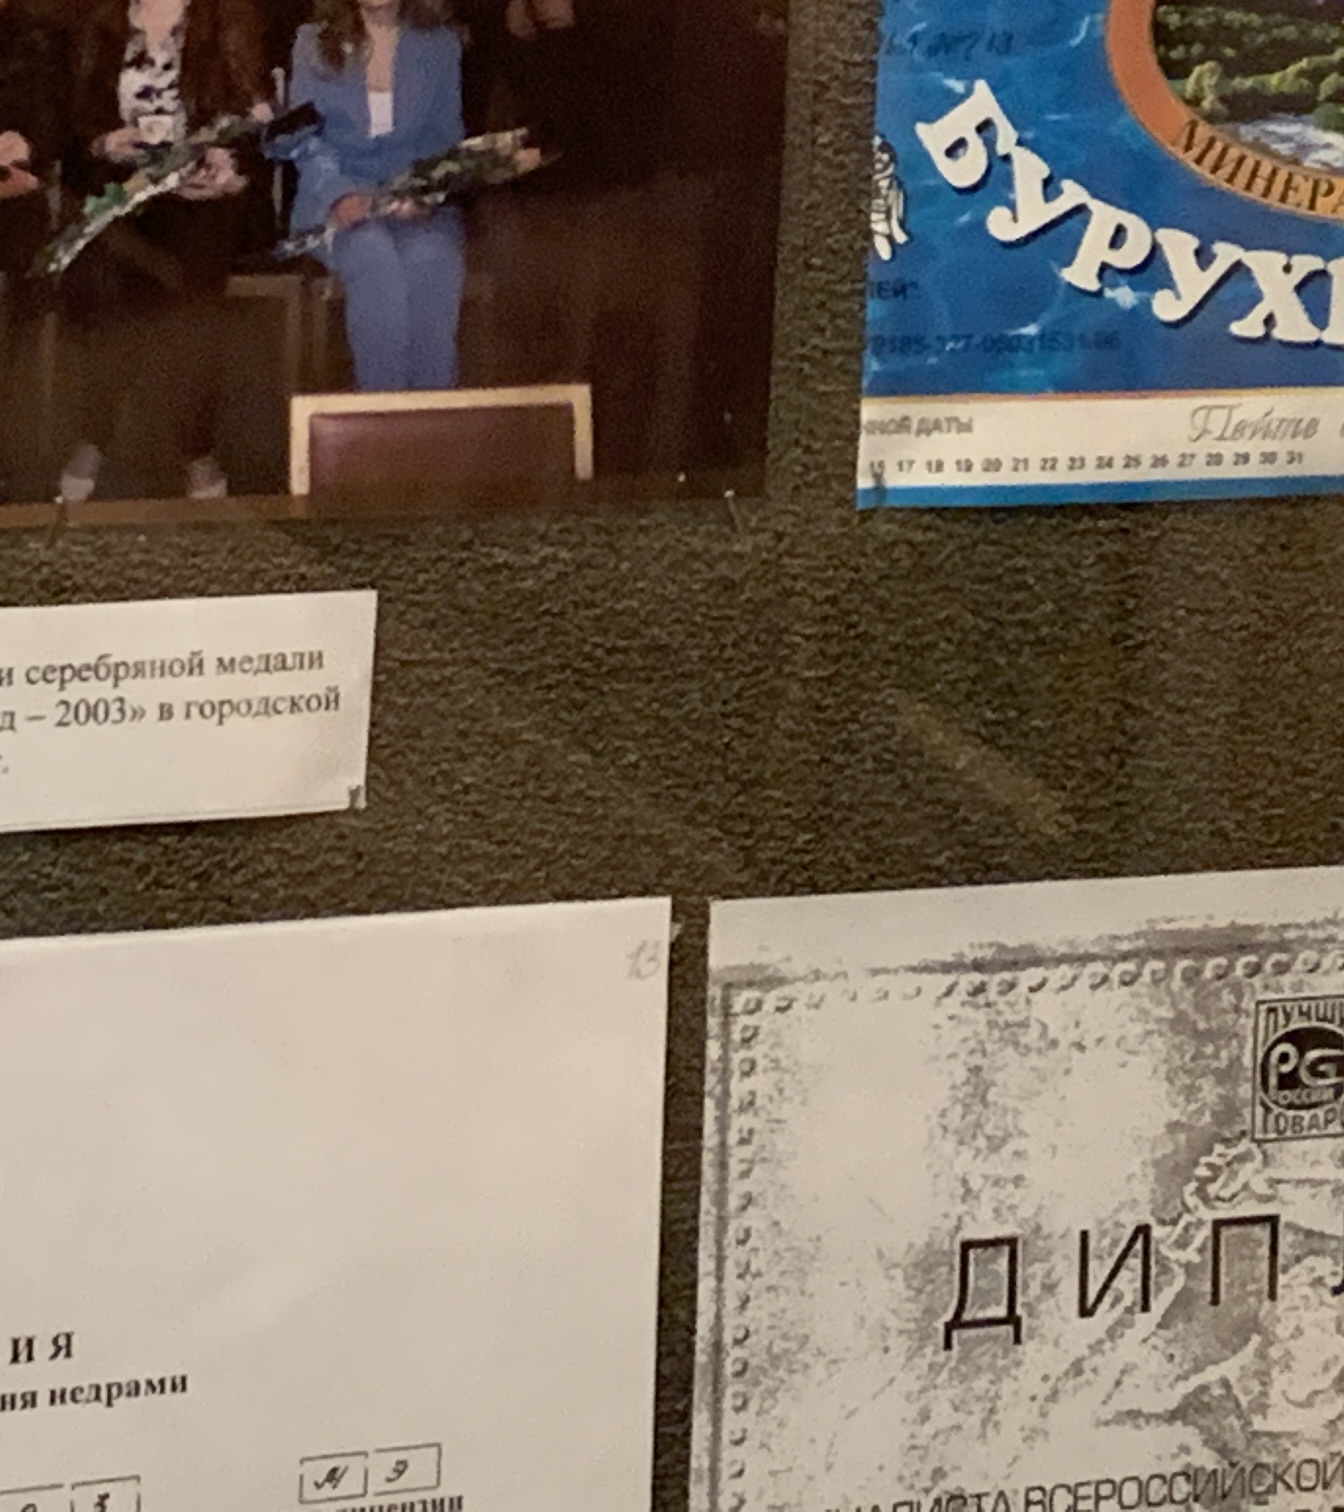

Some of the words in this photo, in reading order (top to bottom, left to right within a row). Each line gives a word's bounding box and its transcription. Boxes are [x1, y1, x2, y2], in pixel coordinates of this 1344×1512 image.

[915, 415, 974, 438] ДАТЫ
[897, 459, 916, 473] 17
[981, 456, 1003, 473] 20
[1011, 456, 1030, 472] 21
[1039, 456, 1059, 471] 22
[1067, 454, 1087, 471] 23
[1121, 453, 1142, 469] 25
[1176, 451, 1197, 468] 27
[1285, 449, 1304, 465] 31
[24, 651, 206, 694] серебряной
[215, 646, 325, 677] медали
[54, 696, 147, 729] 2003»
[157, 704, 175, 723] в
[182, 684, 342, 726] городской
[48, 1373, 190, 1410] недрами
